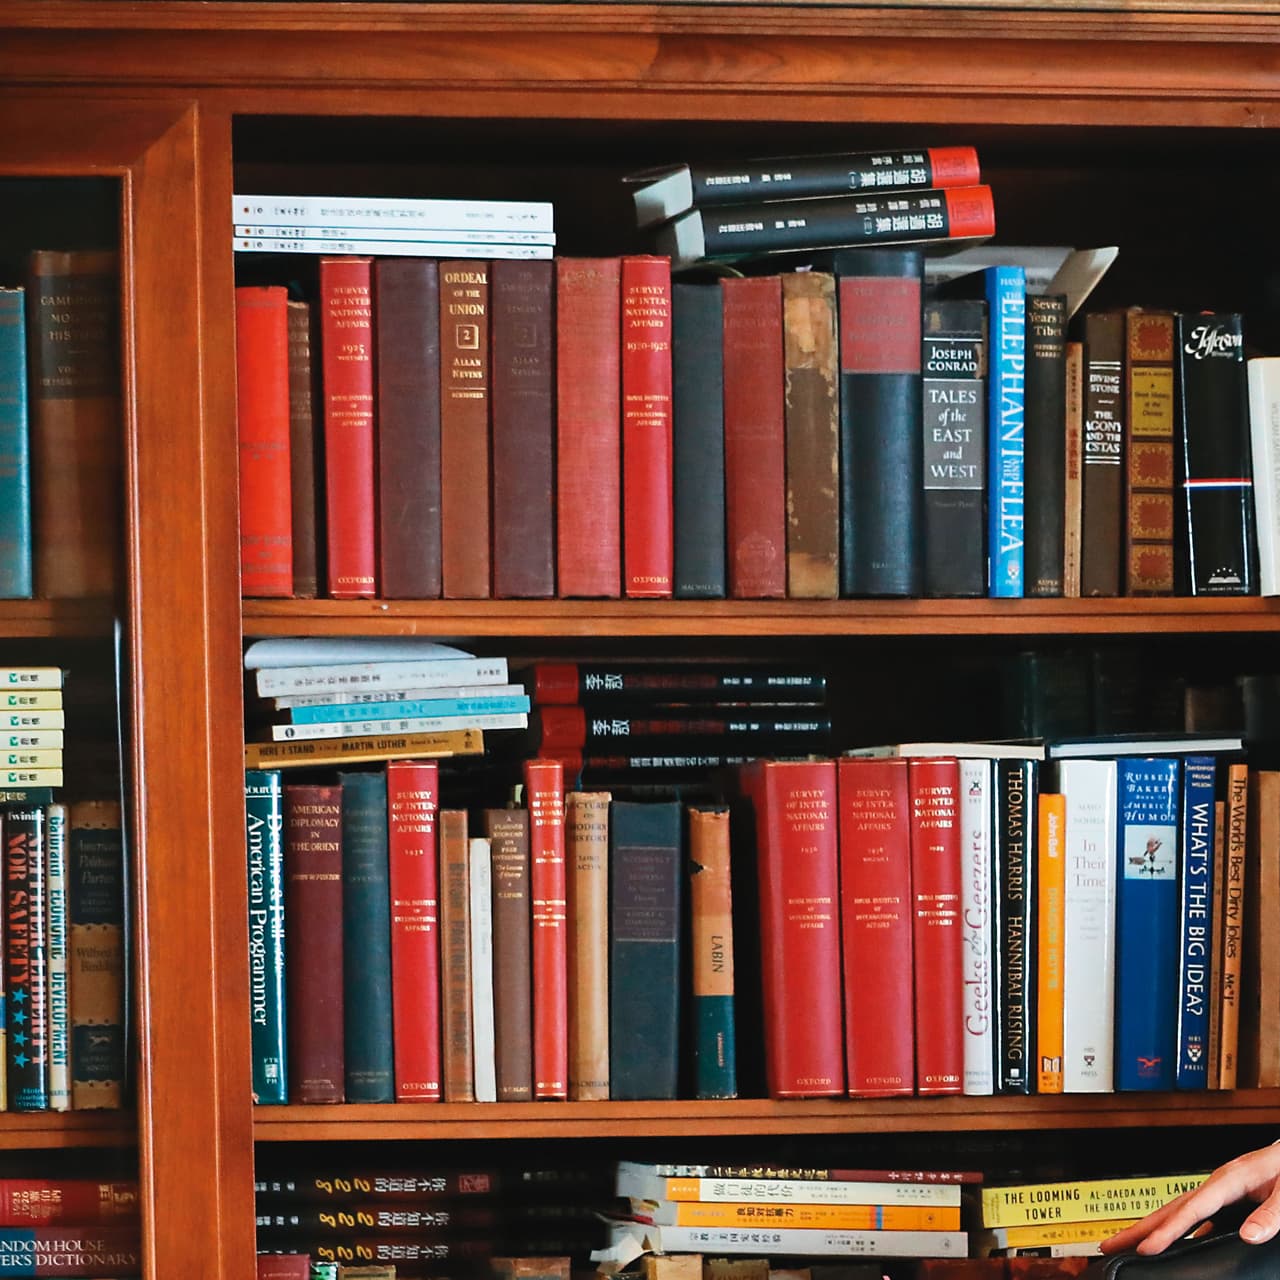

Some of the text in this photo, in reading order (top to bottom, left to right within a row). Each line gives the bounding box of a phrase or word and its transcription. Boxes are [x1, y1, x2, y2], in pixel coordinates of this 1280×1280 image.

[445, 271, 488, 284] ORDEAL
[333, 286, 369, 295] SURVEY
[453, 290, 481, 298] OF THE
[629, 286, 664, 295] SURVEY
[449, 304, 484, 315] UNION
[626, 309, 668, 317] NATIONAL
[630, 320, 664, 328] AFFAIRS
[1184, 325, 1243, 360] Jefferson
[931, 346, 972, 360] JOSEPH
[453, 358, 481, 367] ALLAN
[927, 361, 977, 372] CONRAD
[1090, 374, 1120, 384] IRVING
[1090, 384, 1120, 394] STONE
[928, 389, 977, 404] TALES
[938, 408, 967, 427] of the
[1094, 411, 1112, 420] THE
[1001, 298, 1025, 554] ELEPHANT FLEA
[932, 429, 972, 443] EAST
[943, 447, 962, 460] and
[930, 465, 976, 478] WEST
[337, 576, 375, 584] OXFORD
[633, 576, 669, 584] OXFORD
[585, 673, 625, 690] 李敖
[592, 719, 630, 735] 李敖
[259, 743, 315, 757] HERE STAND
[341, 739, 407, 752] MARTIN LUTHER
[1124, 771, 1177, 782] RUSSELL
[397, 791, 431, 800] SURVEY
[789, 790, 825, 798] SURVEY
[291, 805, 340, 814] AMERICAN
[406, 802, 436, 810] INTER-
[799, 801, 830, 809] INTER-
[392, 813, 434, 822] NATIONAL
[787, 812, 830, 820] NATIONAL
[1124, 812, 1176, 822] HUMOR
[290, 819, 340, 828] DIPLOMACY
[397, 824, 431, 833] AFFAIRS
[291, 842, 340, 851] THE ORIENT
[1082, 840, 1097, 853] In
[1073, 857, 1106, 871] Their
[1226, 777, 1247, 959] The World's Best Dirty Jokes
[1073, 873, 1106, 888] Time
[9, 834, 29, 984] NOR SAFETY
[1007, 769, 1024, 1061] THOMAS HARRIS HANNIBAL RISING
[1186, 803, 1209, 1016] WHAT'S THE BIG IDEA?
[248, 813, 267, 1026] American Programmer
[711, 935, 725, 974] LABIN
[52, 972, 68, 1066] DEVELOPMENT
[403, 1082, 438, 1090] OXFORD
[713, 1179, 795, 1198] 做门徒的代价
[1089, 1187, 1157, 1200] AL-QAEDA AND
[1004, 1189, 1080, 1205] THE LOOMING
[736, 1206, 794, 1218] 良知对抗暴力
[1084, 1199, 1164, 1213] THE ROAD TO 9/11
[1025, 1207, 1062, 1221] TOWER
[690, 1229, 782, 1244] 宗教与美国宪政经验
[54, 1240, 105, 1252] HOUSE
[36, 1254, 137, 1266] DICTIONARY
